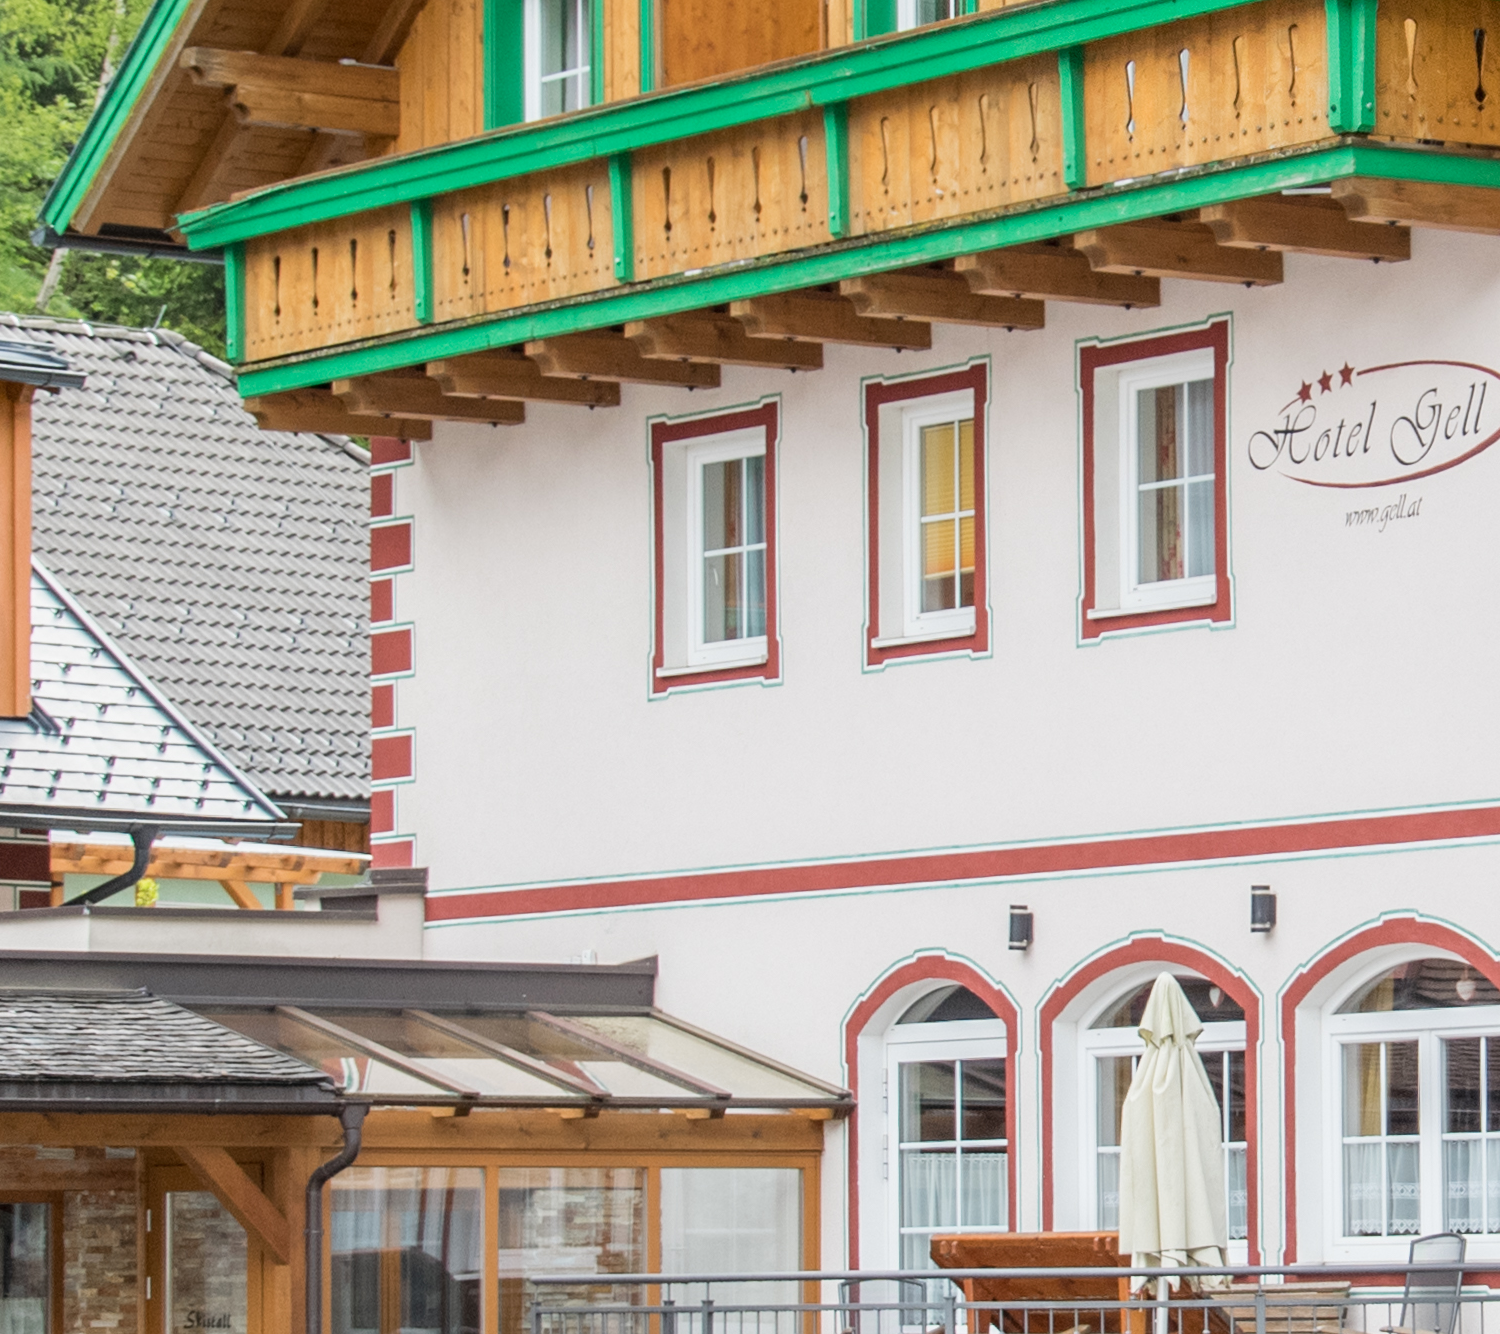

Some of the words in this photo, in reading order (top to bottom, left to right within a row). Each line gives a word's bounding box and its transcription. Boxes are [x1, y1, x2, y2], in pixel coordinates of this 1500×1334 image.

[1247, 399, 1378, 471] Hotel
[1389, 380, 1488, 466] Gell
[1344, 493, 1423, 533] www.gell.at
